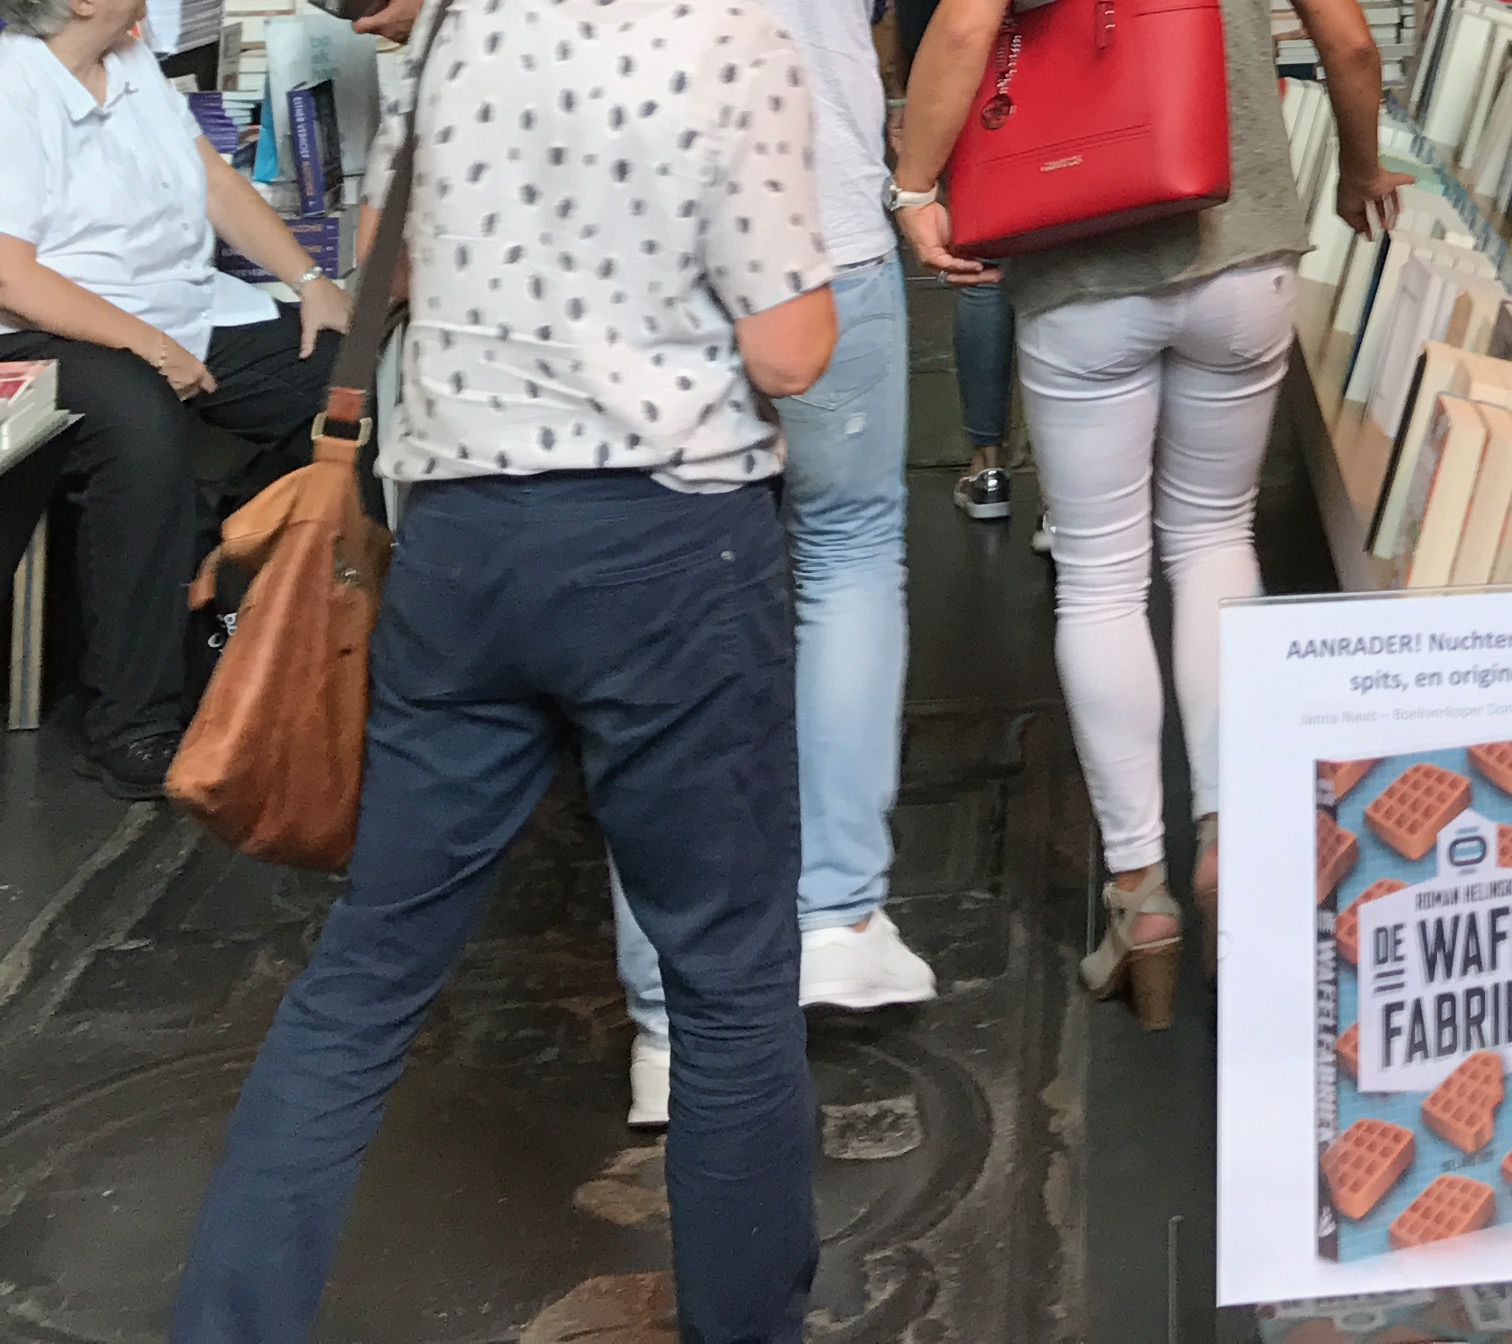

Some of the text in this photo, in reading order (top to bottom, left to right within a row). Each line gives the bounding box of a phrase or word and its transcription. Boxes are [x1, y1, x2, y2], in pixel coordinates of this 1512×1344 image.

[1286, 635, 1422, 660] AANRADER!
[1349, 669, 1409, 695] spits,
[1414, 670, 1443, 688] en
[1372, 920, 1407, 968] DE
